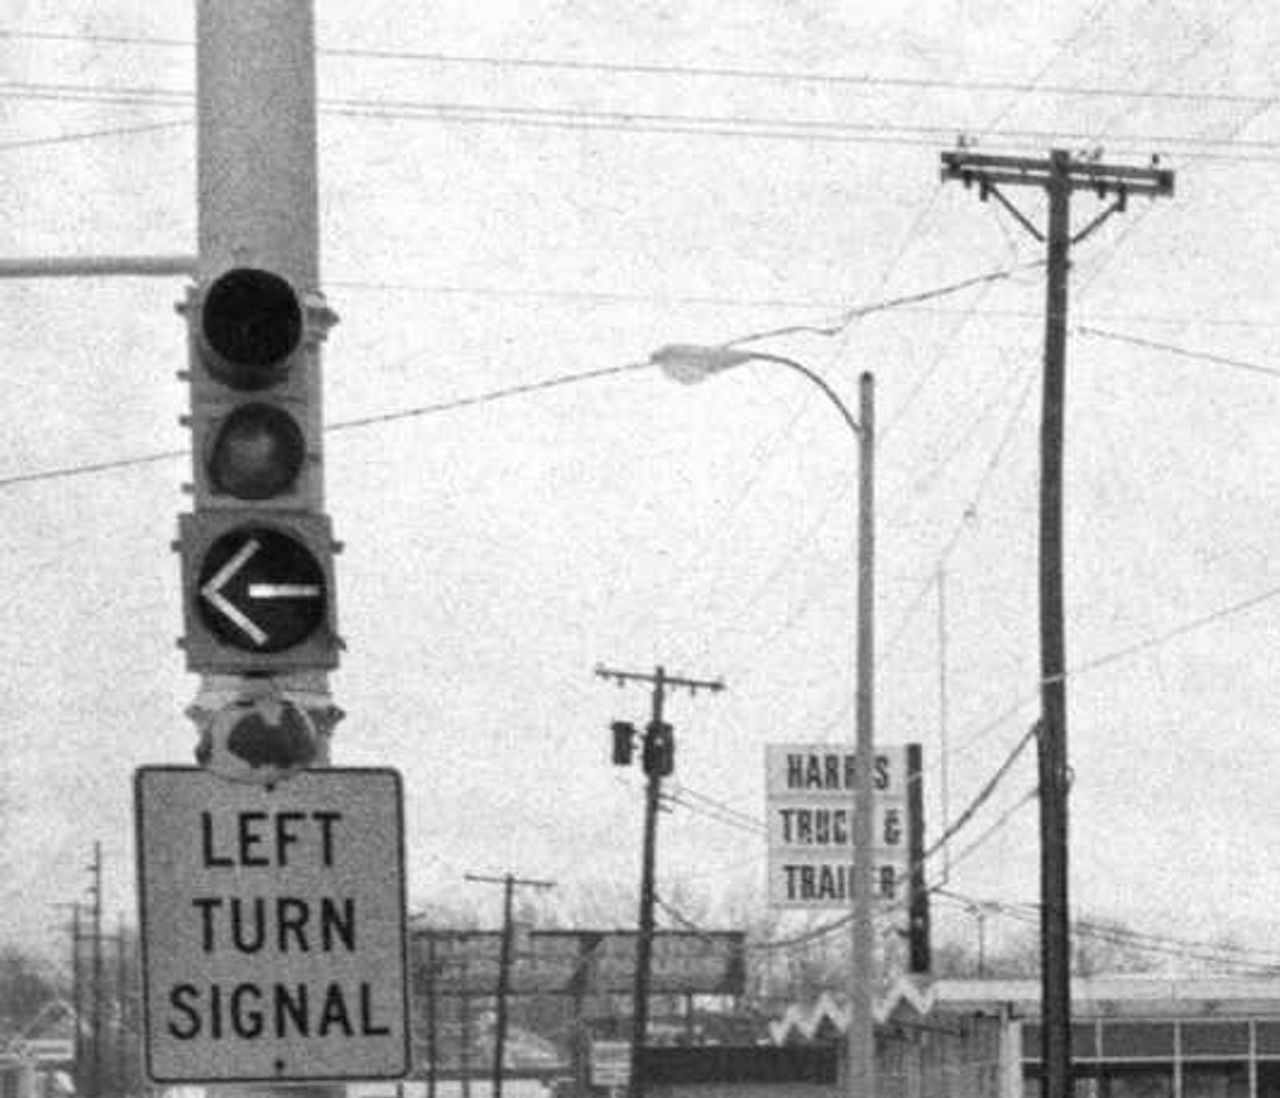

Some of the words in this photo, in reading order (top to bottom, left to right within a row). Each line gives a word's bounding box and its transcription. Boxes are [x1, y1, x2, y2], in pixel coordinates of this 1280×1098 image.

[201, 811, 342, 867] LEFT
[778, 809, 868, 844] TRUC
[883, 809, 901, 845] &
[192, 897, 357, 952] TURN
[168, 983, 391, 1040] SIGNAL
